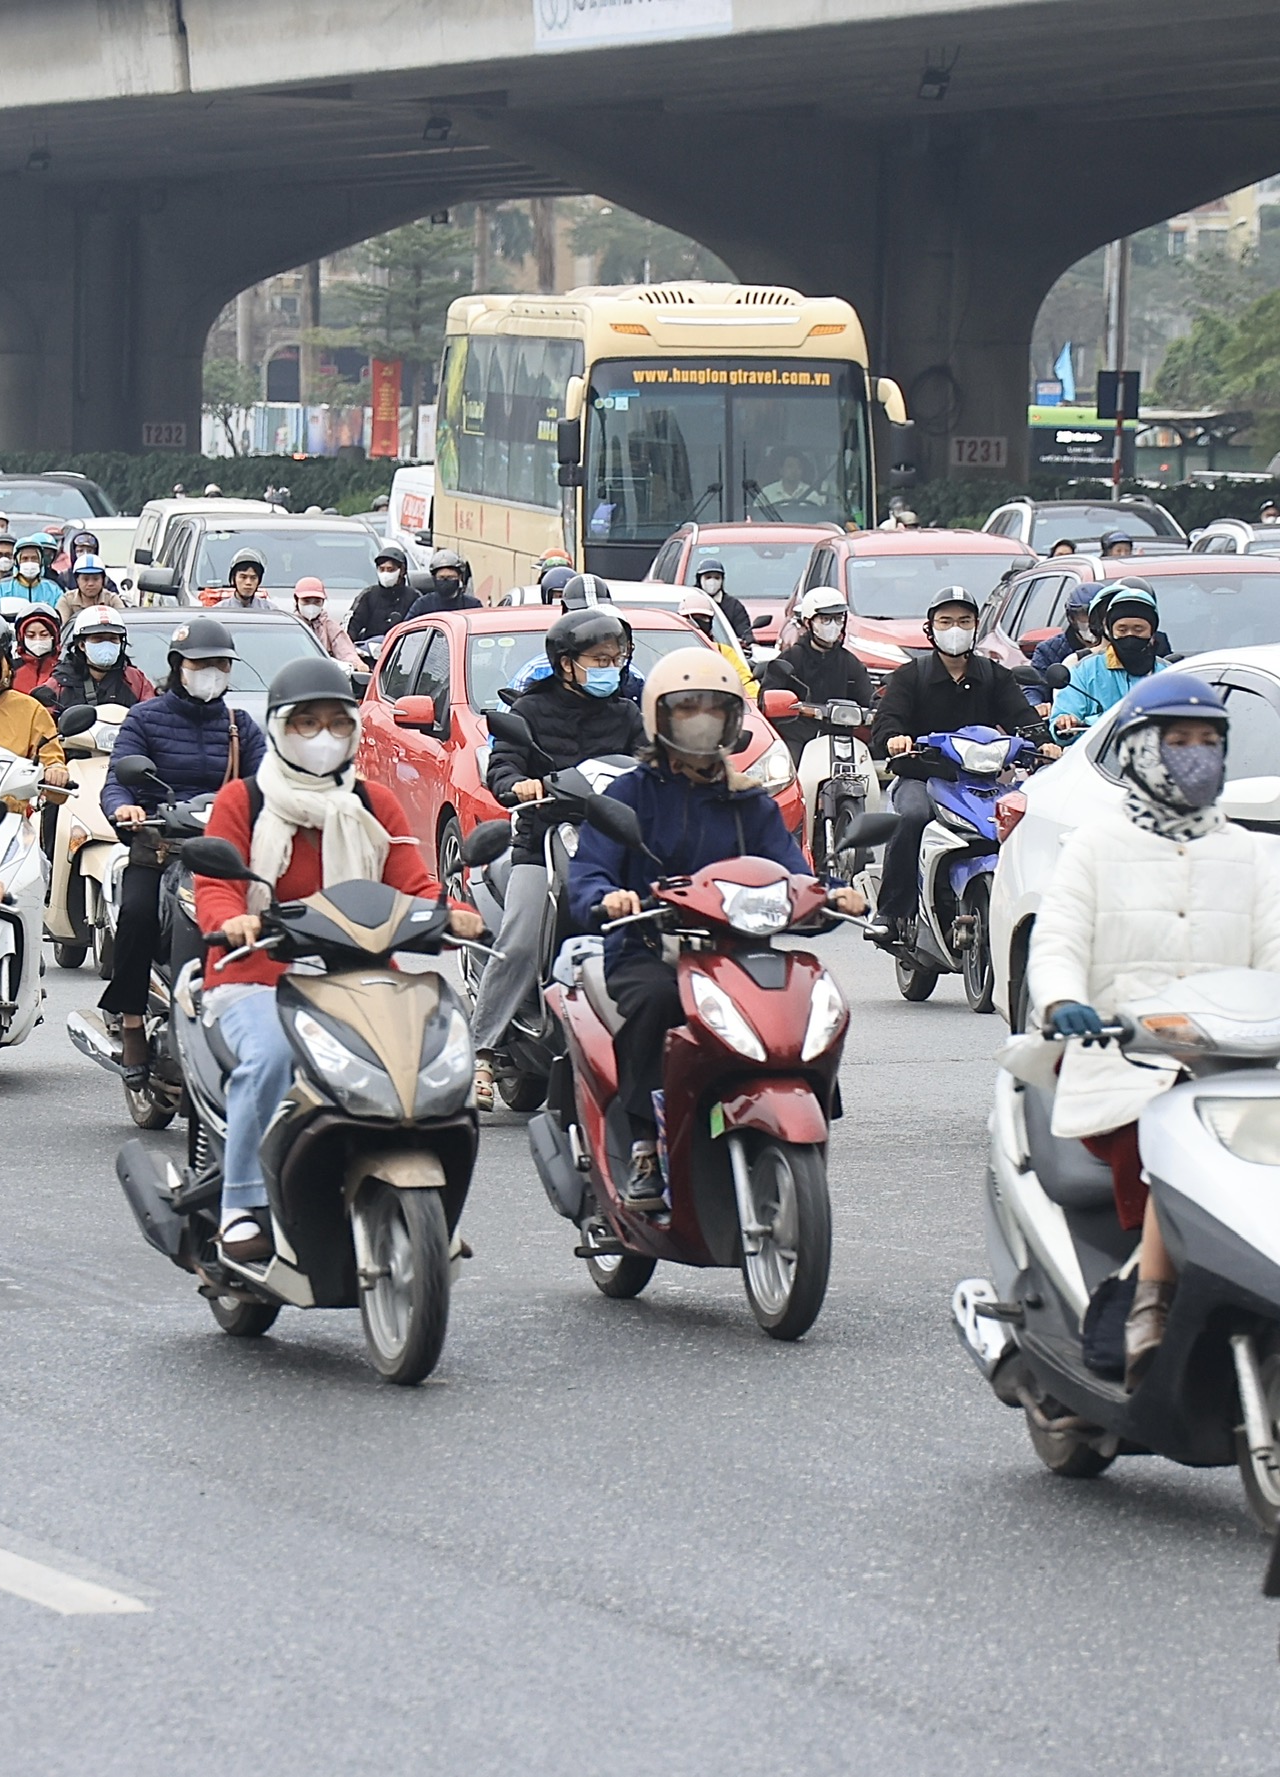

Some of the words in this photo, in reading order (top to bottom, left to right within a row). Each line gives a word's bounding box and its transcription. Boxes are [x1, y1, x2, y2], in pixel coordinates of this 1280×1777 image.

[632, 368, 831, 386] www.hunglongtravel.com.vn
[145, 425, 183, 444] T232
[956, 439, 1001, 462] T231
